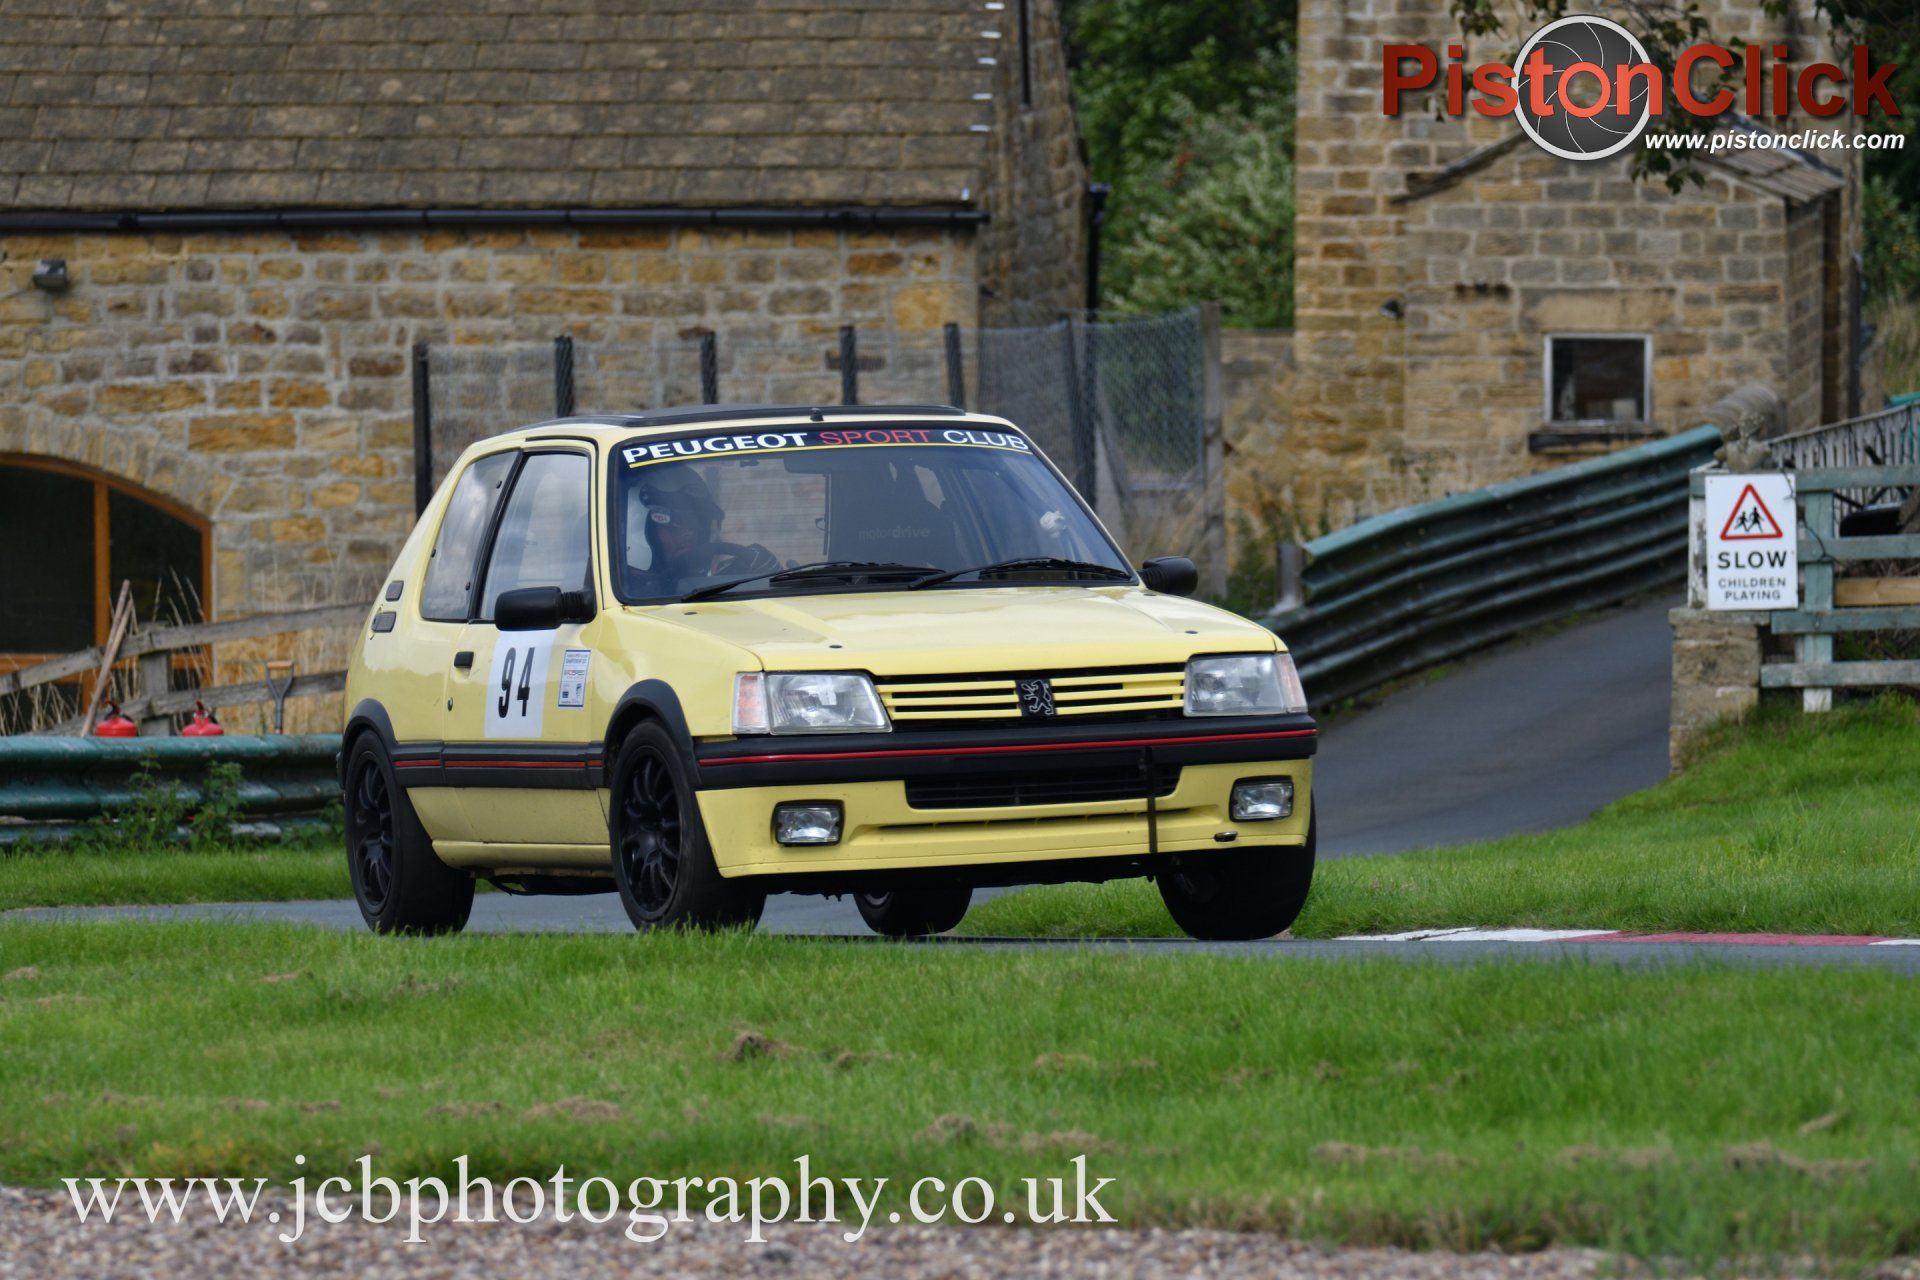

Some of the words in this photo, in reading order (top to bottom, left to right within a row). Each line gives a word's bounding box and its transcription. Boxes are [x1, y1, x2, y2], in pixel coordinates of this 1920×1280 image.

[622, 432, 808, 463] PEUGEOT
[819, 430, 930, 445] SPORT
[943, 430, 1029, 450] CLUB
[1718, 551, 1787, 569] SLOW
[1718, 578, 1786, 588] CHILDREN
[1725, 591, 1781, 600] PLAYING
[498, 647, 535, 718] 94
